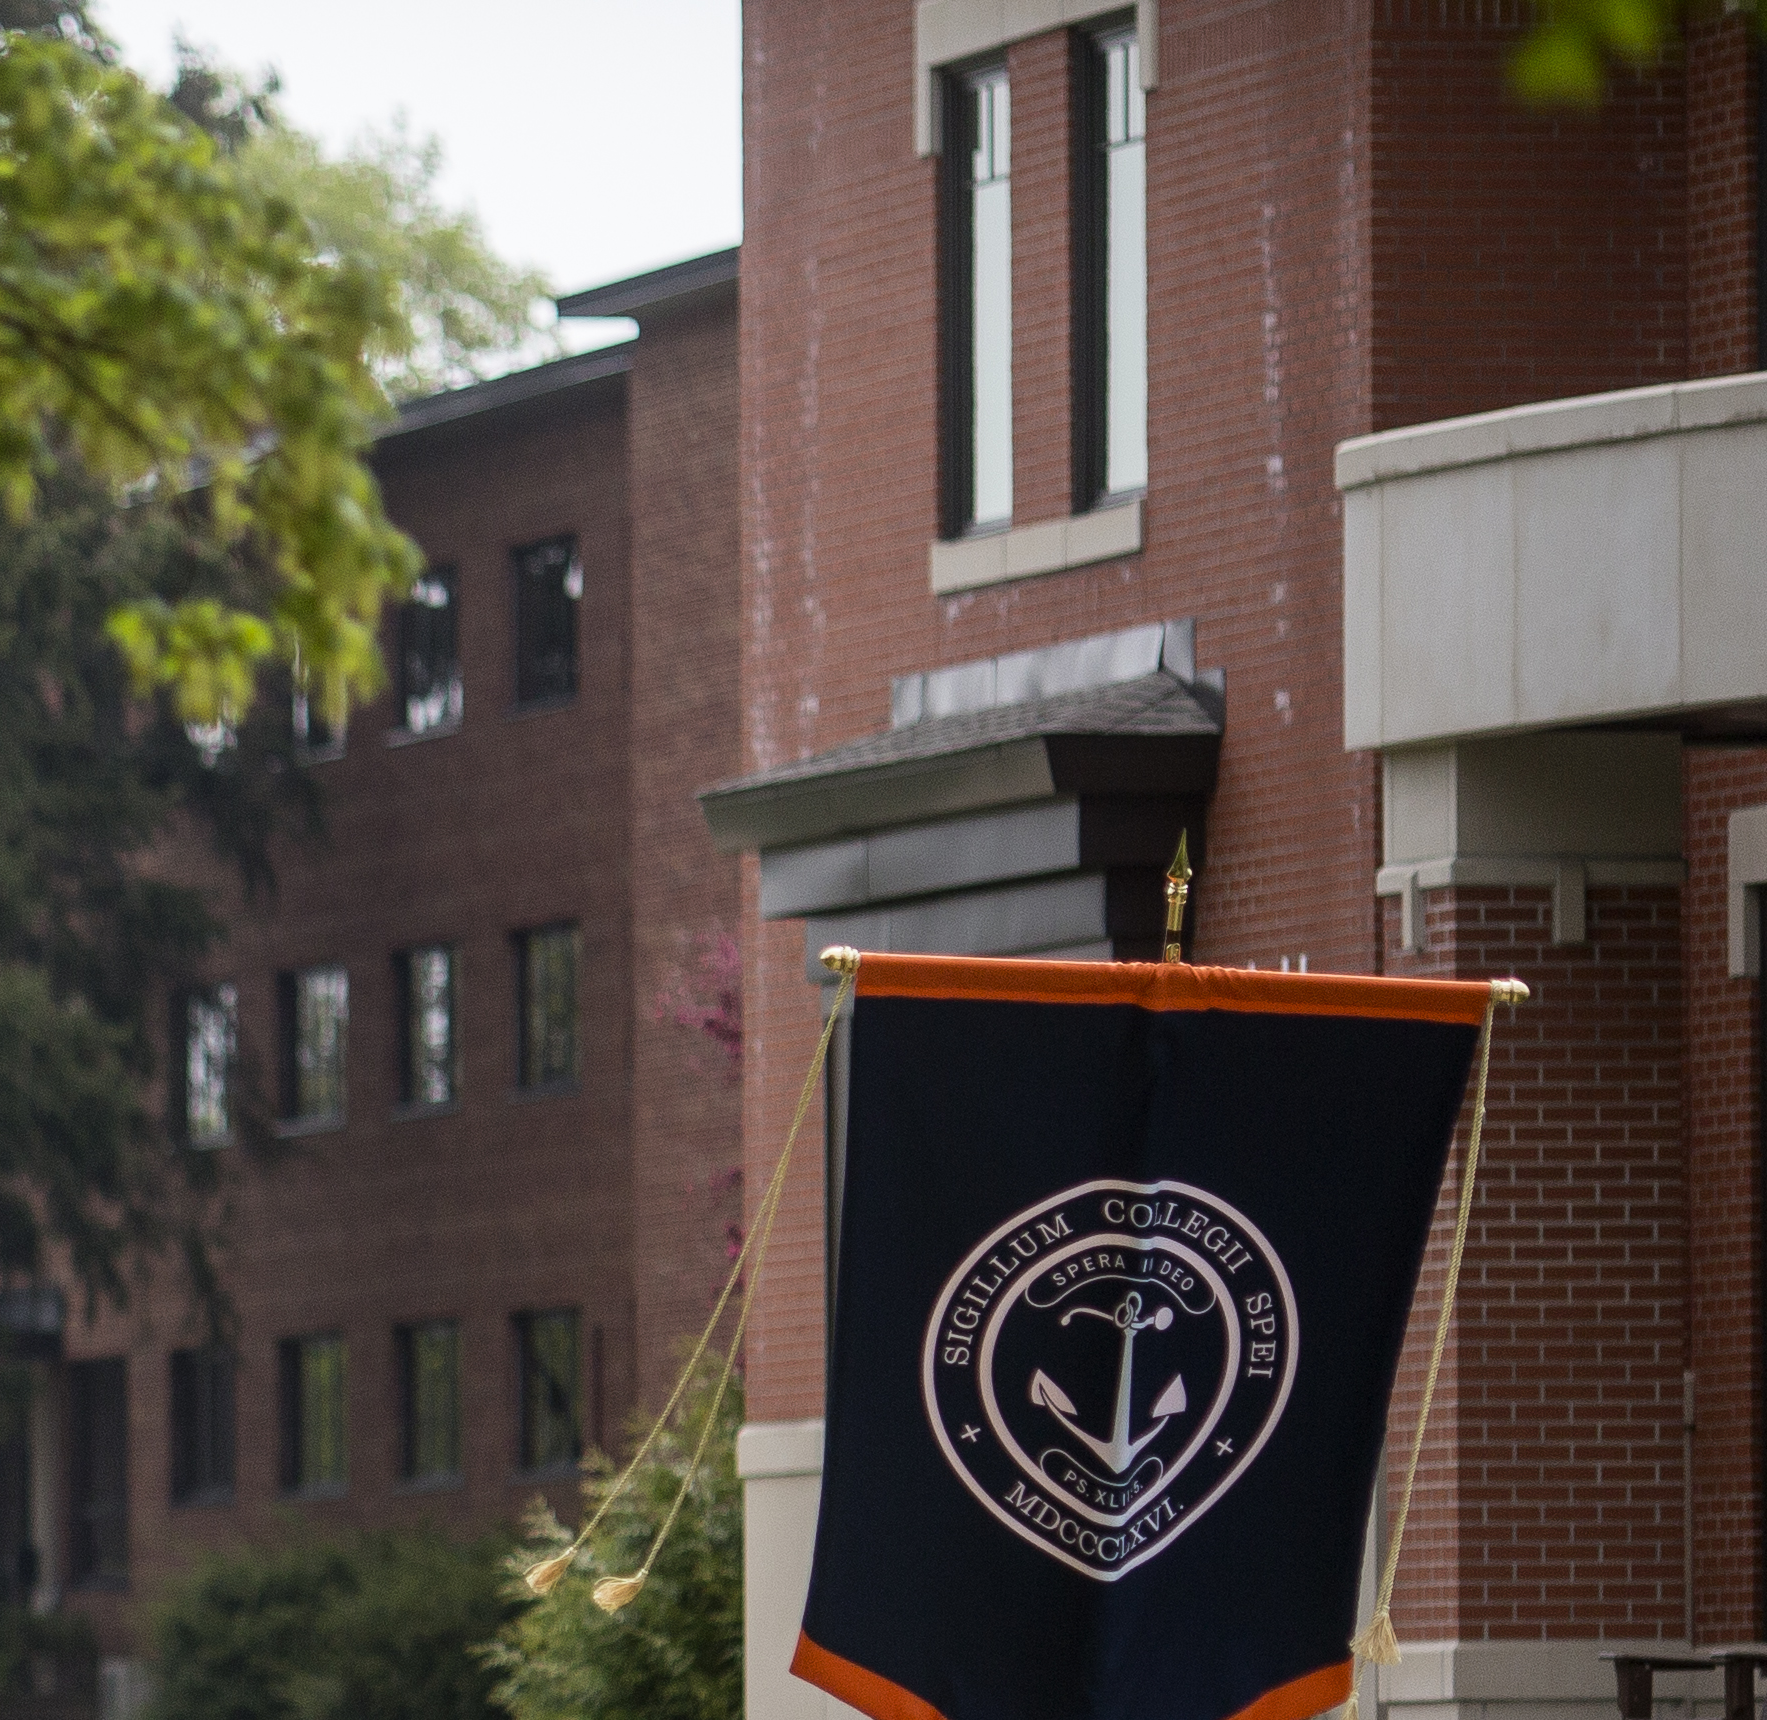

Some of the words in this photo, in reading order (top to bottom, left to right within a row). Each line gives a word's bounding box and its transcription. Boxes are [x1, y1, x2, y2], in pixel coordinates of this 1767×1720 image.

[944, 1213, 1074, 1366] SIGILLUM
[1103, 1199, 1253, 1275] COLLEGII
[1245, 1292, 1276, 1379] SPEI
[1052, 1254, 1126, 1286] SPERA
[1159, 1260, 1194, 1291] DEO
[1063, 1470, 1090, 1497] PS.
